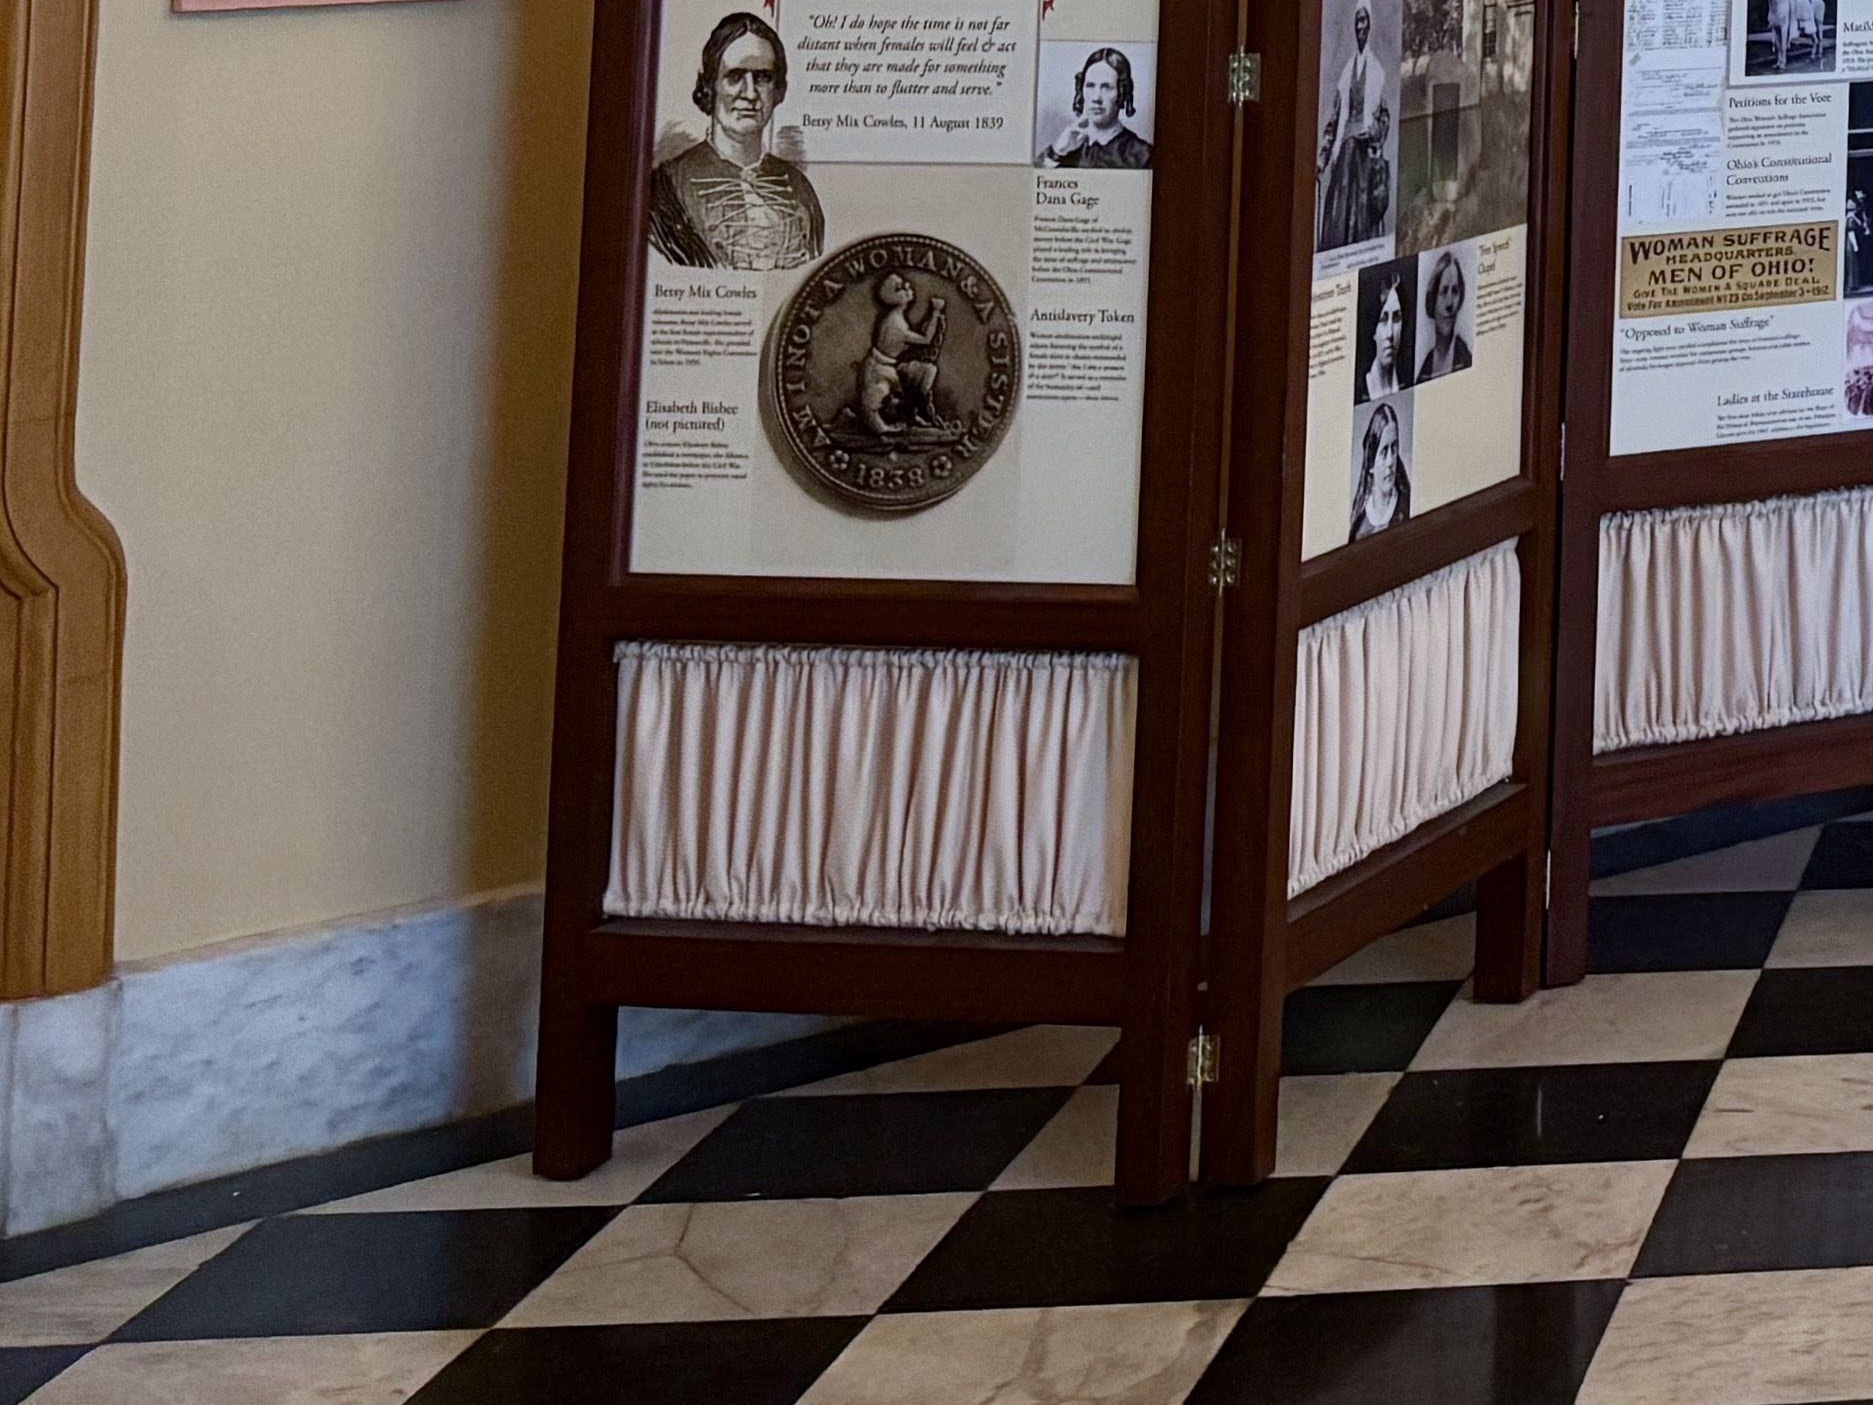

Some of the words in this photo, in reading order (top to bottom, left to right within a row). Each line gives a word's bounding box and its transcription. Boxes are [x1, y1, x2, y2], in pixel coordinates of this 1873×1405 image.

[839, 16, 846, 29] I
[849, 16, 865, 30] do
[868, 16, 898, 35] hope
[901, 16, 920, 30] the
[923, 17, 951, 30] time
[954, 18, 964, 30] is
[968, 20, 989, 30] not
[989, 16, 1011, 35] far
[797, 36, 840, 50] distant
[843, 36, 876, 50] when
[877, 36, 925, 54] females
[928, 37, 953, 52] will
[954, 37, 977, 54] feel
[981, 38, 993, 52] &
[996, 40, 1017, 52] act
[806, 58, 832, 72] that
[835, 58, 858, 76] they
[863, 62, 883, 73] are
[886, 59, 919, 73] made
[920, 59, 941, 77] for
[943, 60, 1006, 77] something
[809, 82, 840, 93] more
[843, 80, 872, 93] than
[875, 82, 887, 94] to
[888, 80, 930, 98] flutter
[932, 81, 956, 95] and
[1729, 97, 1771, 108] Petitions
[1775, 94, 1788, 106] for
[1791, 93, 1807, 104] the
[802, 114, 831, 128] Betsy
[836, 114, 859, 127] Mix
[913, 115, 925, 127] 11
[930, 117, 970, 132] August
[975, 116, 1003, 129] 1839
[1036, 176, 1078, 189] Frances
[1036, 192, 1067, 205] Dana
[1070, 192, 1100, 210] Gage
[1630, 235, 1715, 265] WOMAN
[1723, 227, 1831, 251] SUFFRAGE
[1666, 246, 1794, 265] HEADQUARTERS
[845, 246, 964, 278] WOMAN
[1648, 266, 1703, 286] MEN
[1711, 264, 1743, 280] OF
[1751, 258, 1814, 277] OHIO!
[655, 284, 686, 301] Betsy
[688, 285, 711, 298] Mix
[715, 285, 757, 299] Cowles
[823, 279, 844, 298] A
[960, 275, 978, 298] &
[975, 300, 996, 323] A
[1098, 309, 1135, 323] Token
[788, 303, 821, 368] NOT
[786, 381, 806, 392] I
[956, 331, 1010, 458] SISTER
[793, 404, 831, 448] AM
[857, 463, 924, 488] 1838
